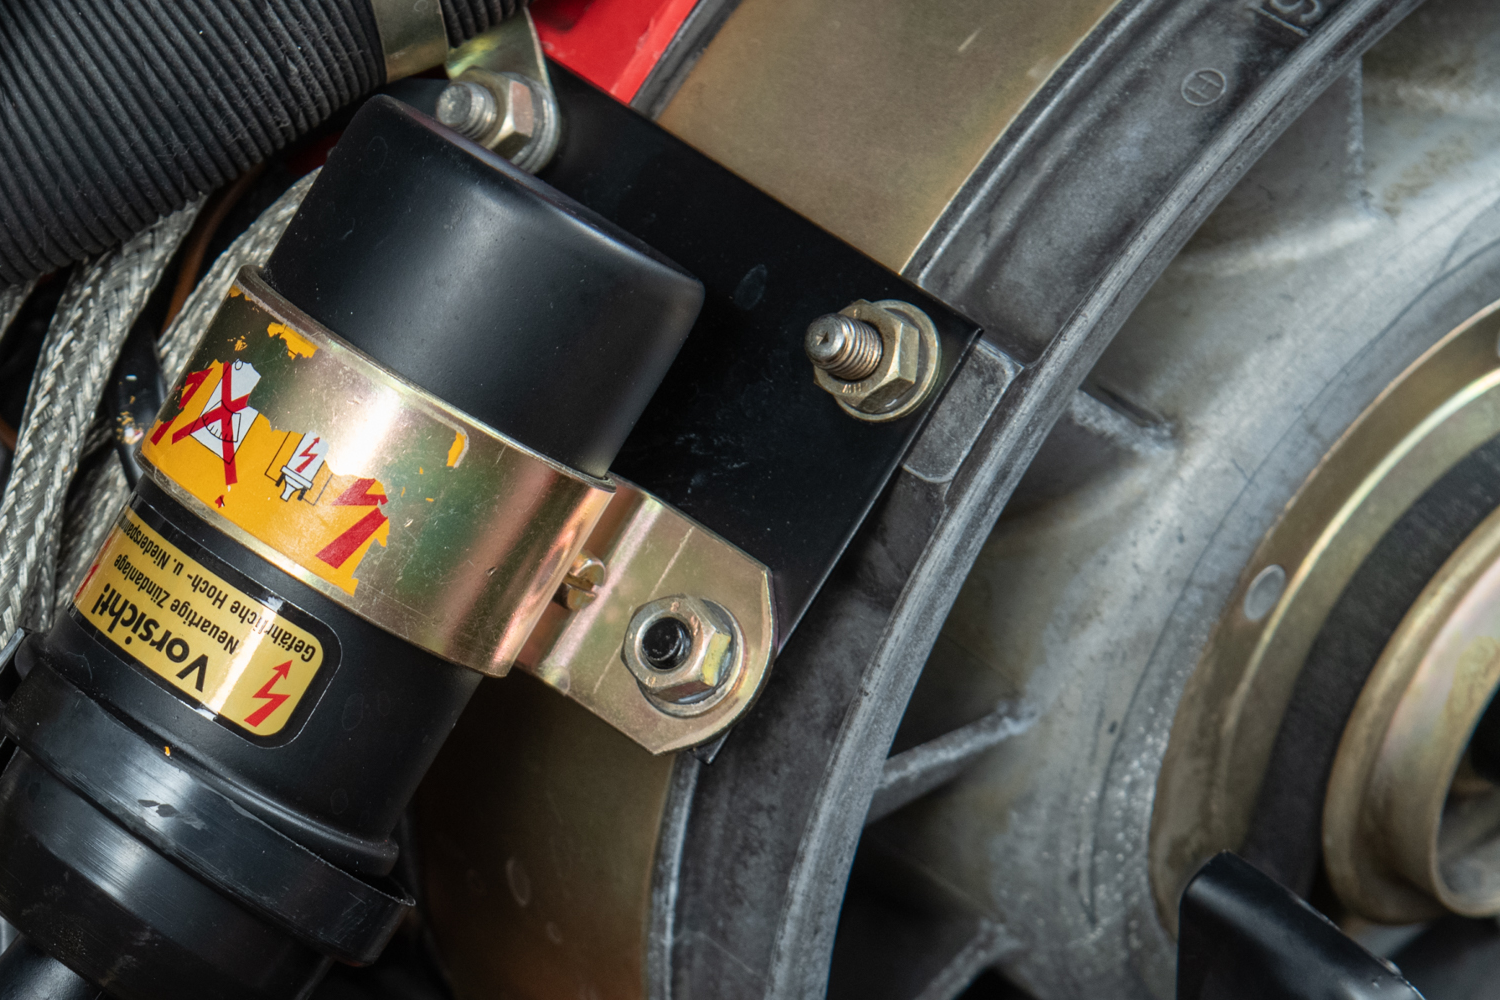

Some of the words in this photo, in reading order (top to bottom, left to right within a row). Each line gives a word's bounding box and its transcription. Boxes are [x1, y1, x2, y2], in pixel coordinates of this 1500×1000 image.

[113, 552, 171, 607] Zündanlage
[172, 557, 186, 577] u.
[186, 572, 229, 614] Hoch-
[91, 583, 210, 693] Vorsicht!
[170, 596, 241, 655] Neuartige
[229, 599, 317, 663] Gefährliche
